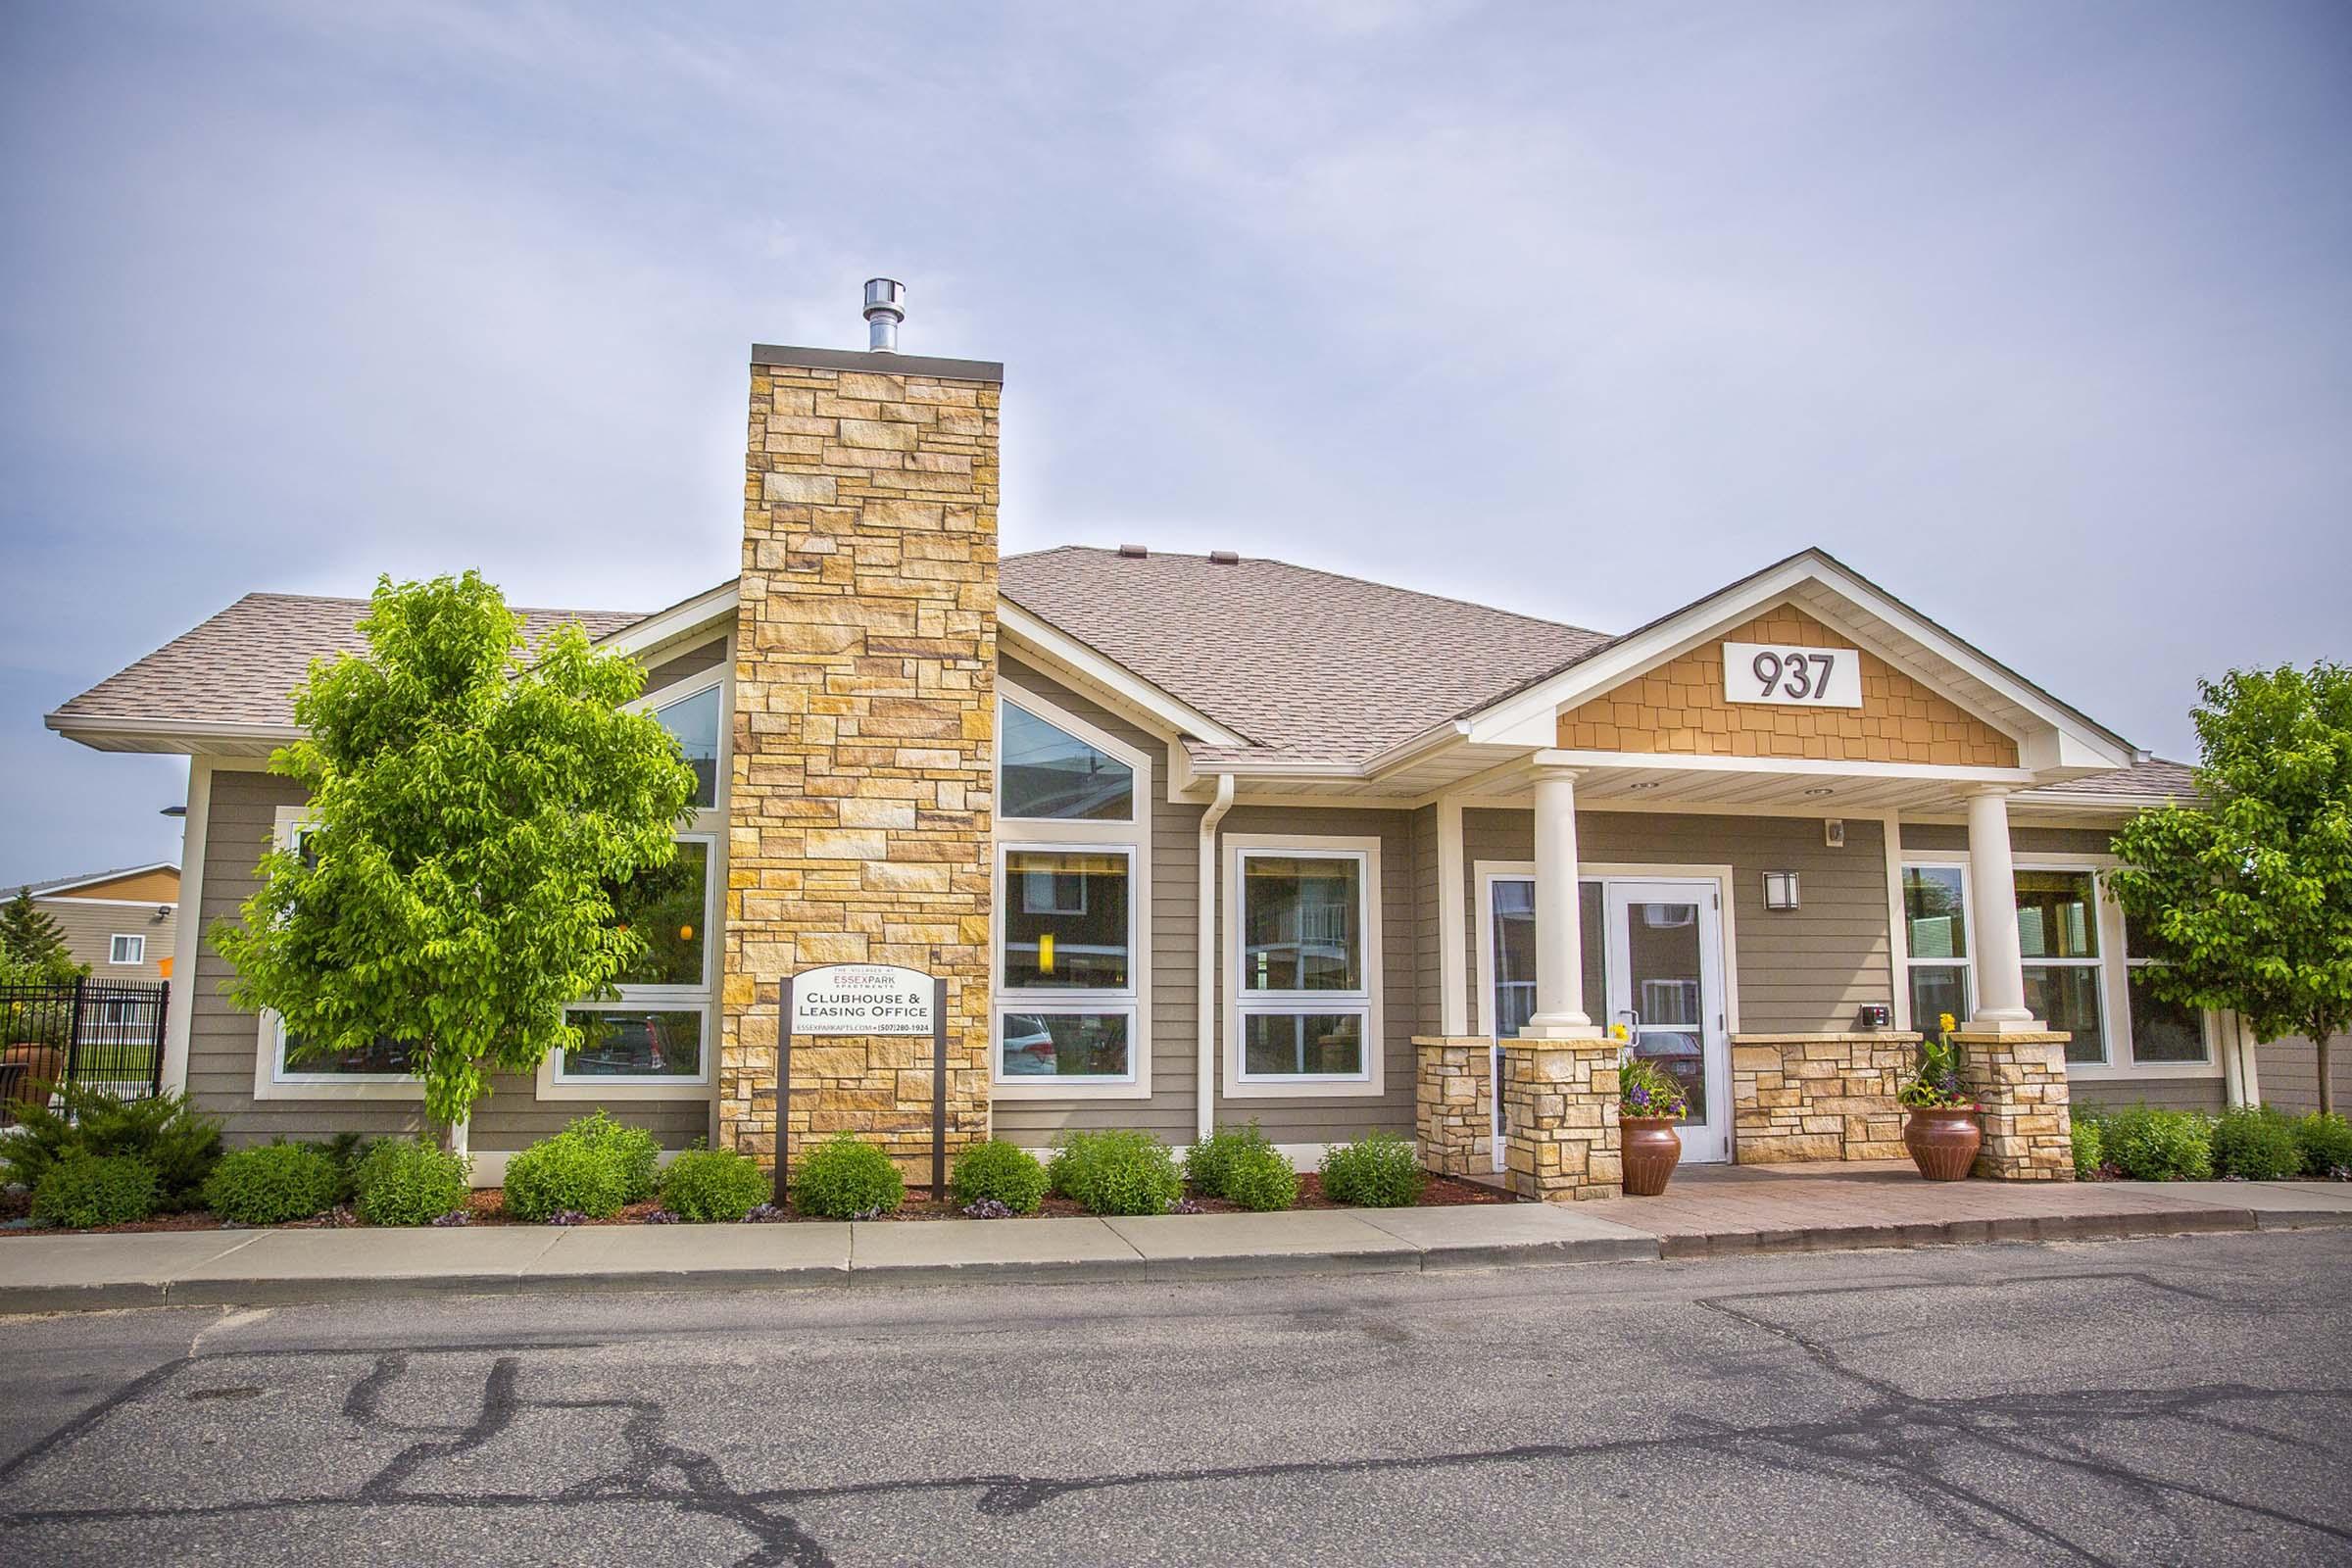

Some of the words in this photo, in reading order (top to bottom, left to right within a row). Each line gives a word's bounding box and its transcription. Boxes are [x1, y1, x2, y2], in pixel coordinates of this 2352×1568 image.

[1752, 651, 1836, 700] 937
[834, 974, 896, 984] ESSEXPARK
[807, 992, 904, 1004] CLUBHOUSE
[908, 993, 921, 1004] &
[800, 1005, 865, 1017] LEASING
[871, 1005, 928, 1017] OFFICE
